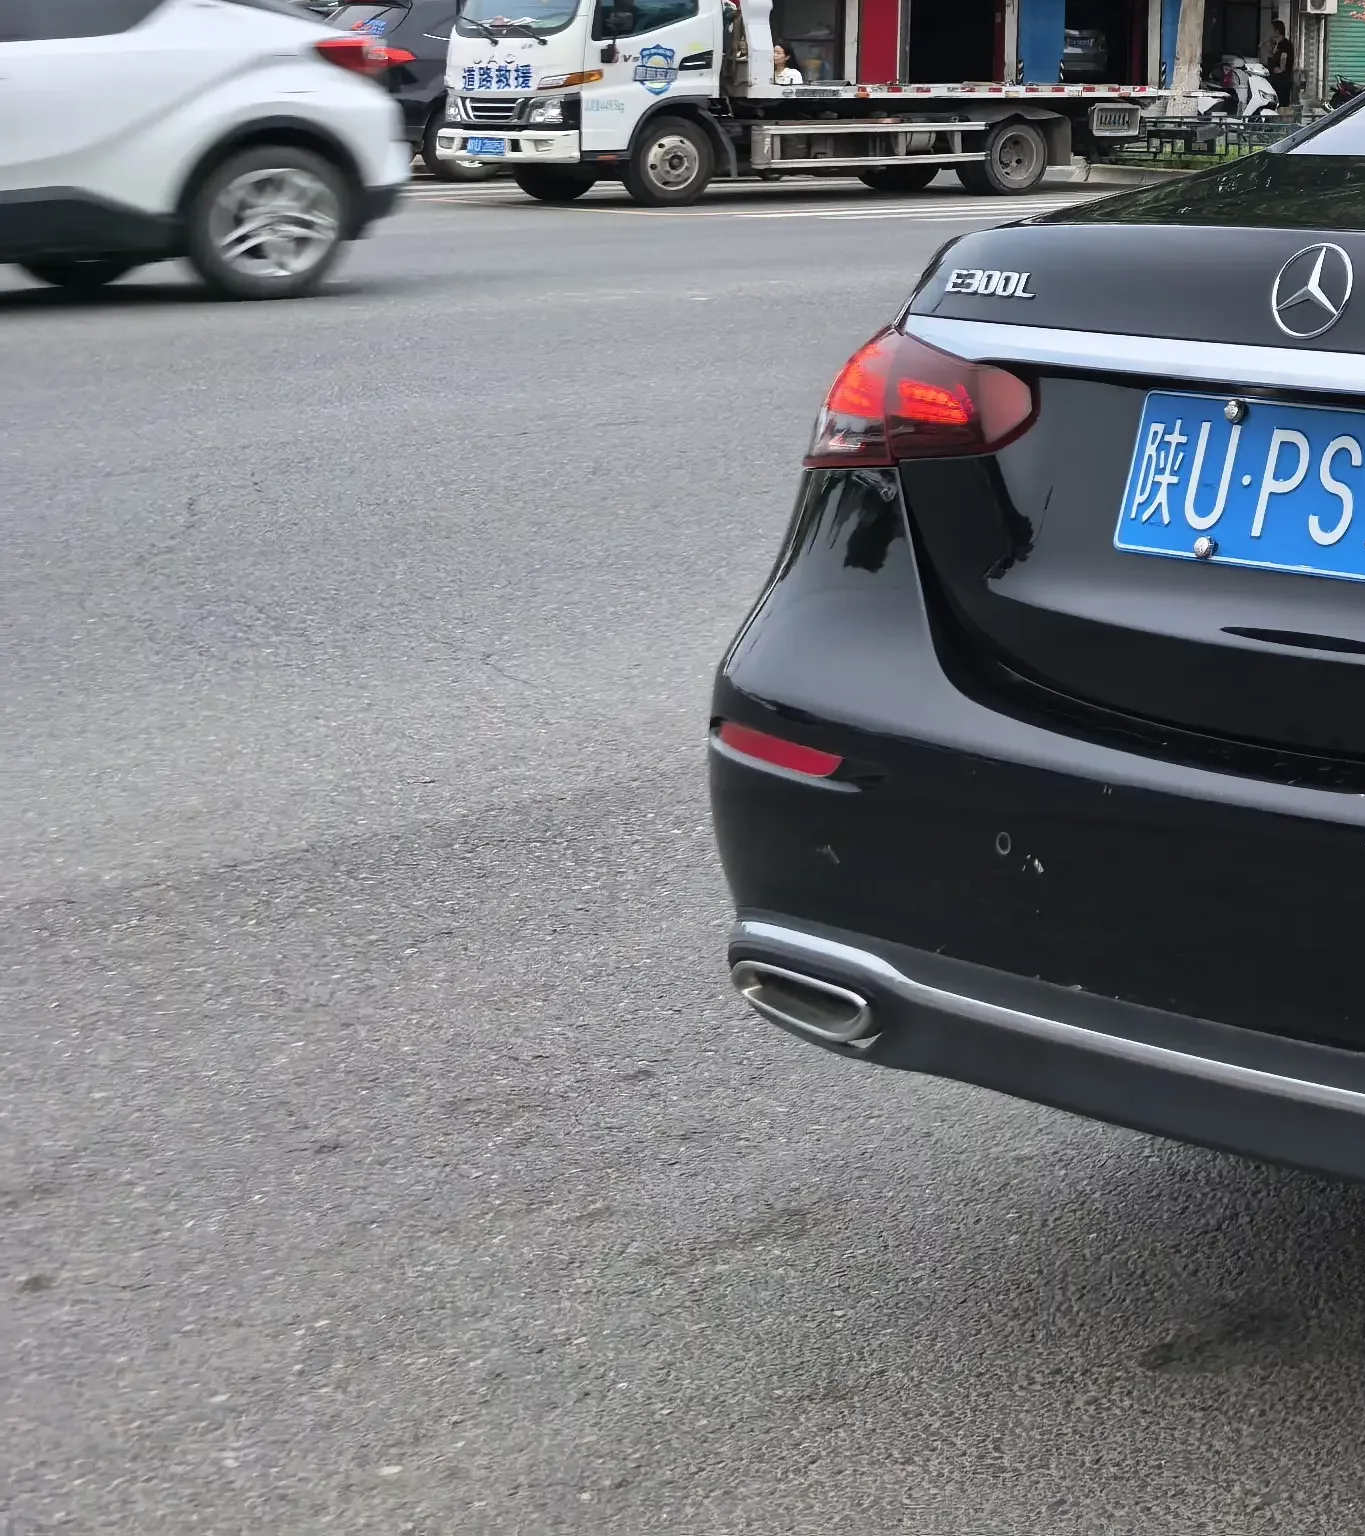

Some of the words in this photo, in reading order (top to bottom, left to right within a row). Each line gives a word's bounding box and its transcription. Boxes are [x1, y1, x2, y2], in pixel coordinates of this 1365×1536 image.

[462, 64, 532, 92] 道路救援
[945, 269, 1037, 298] E300L
